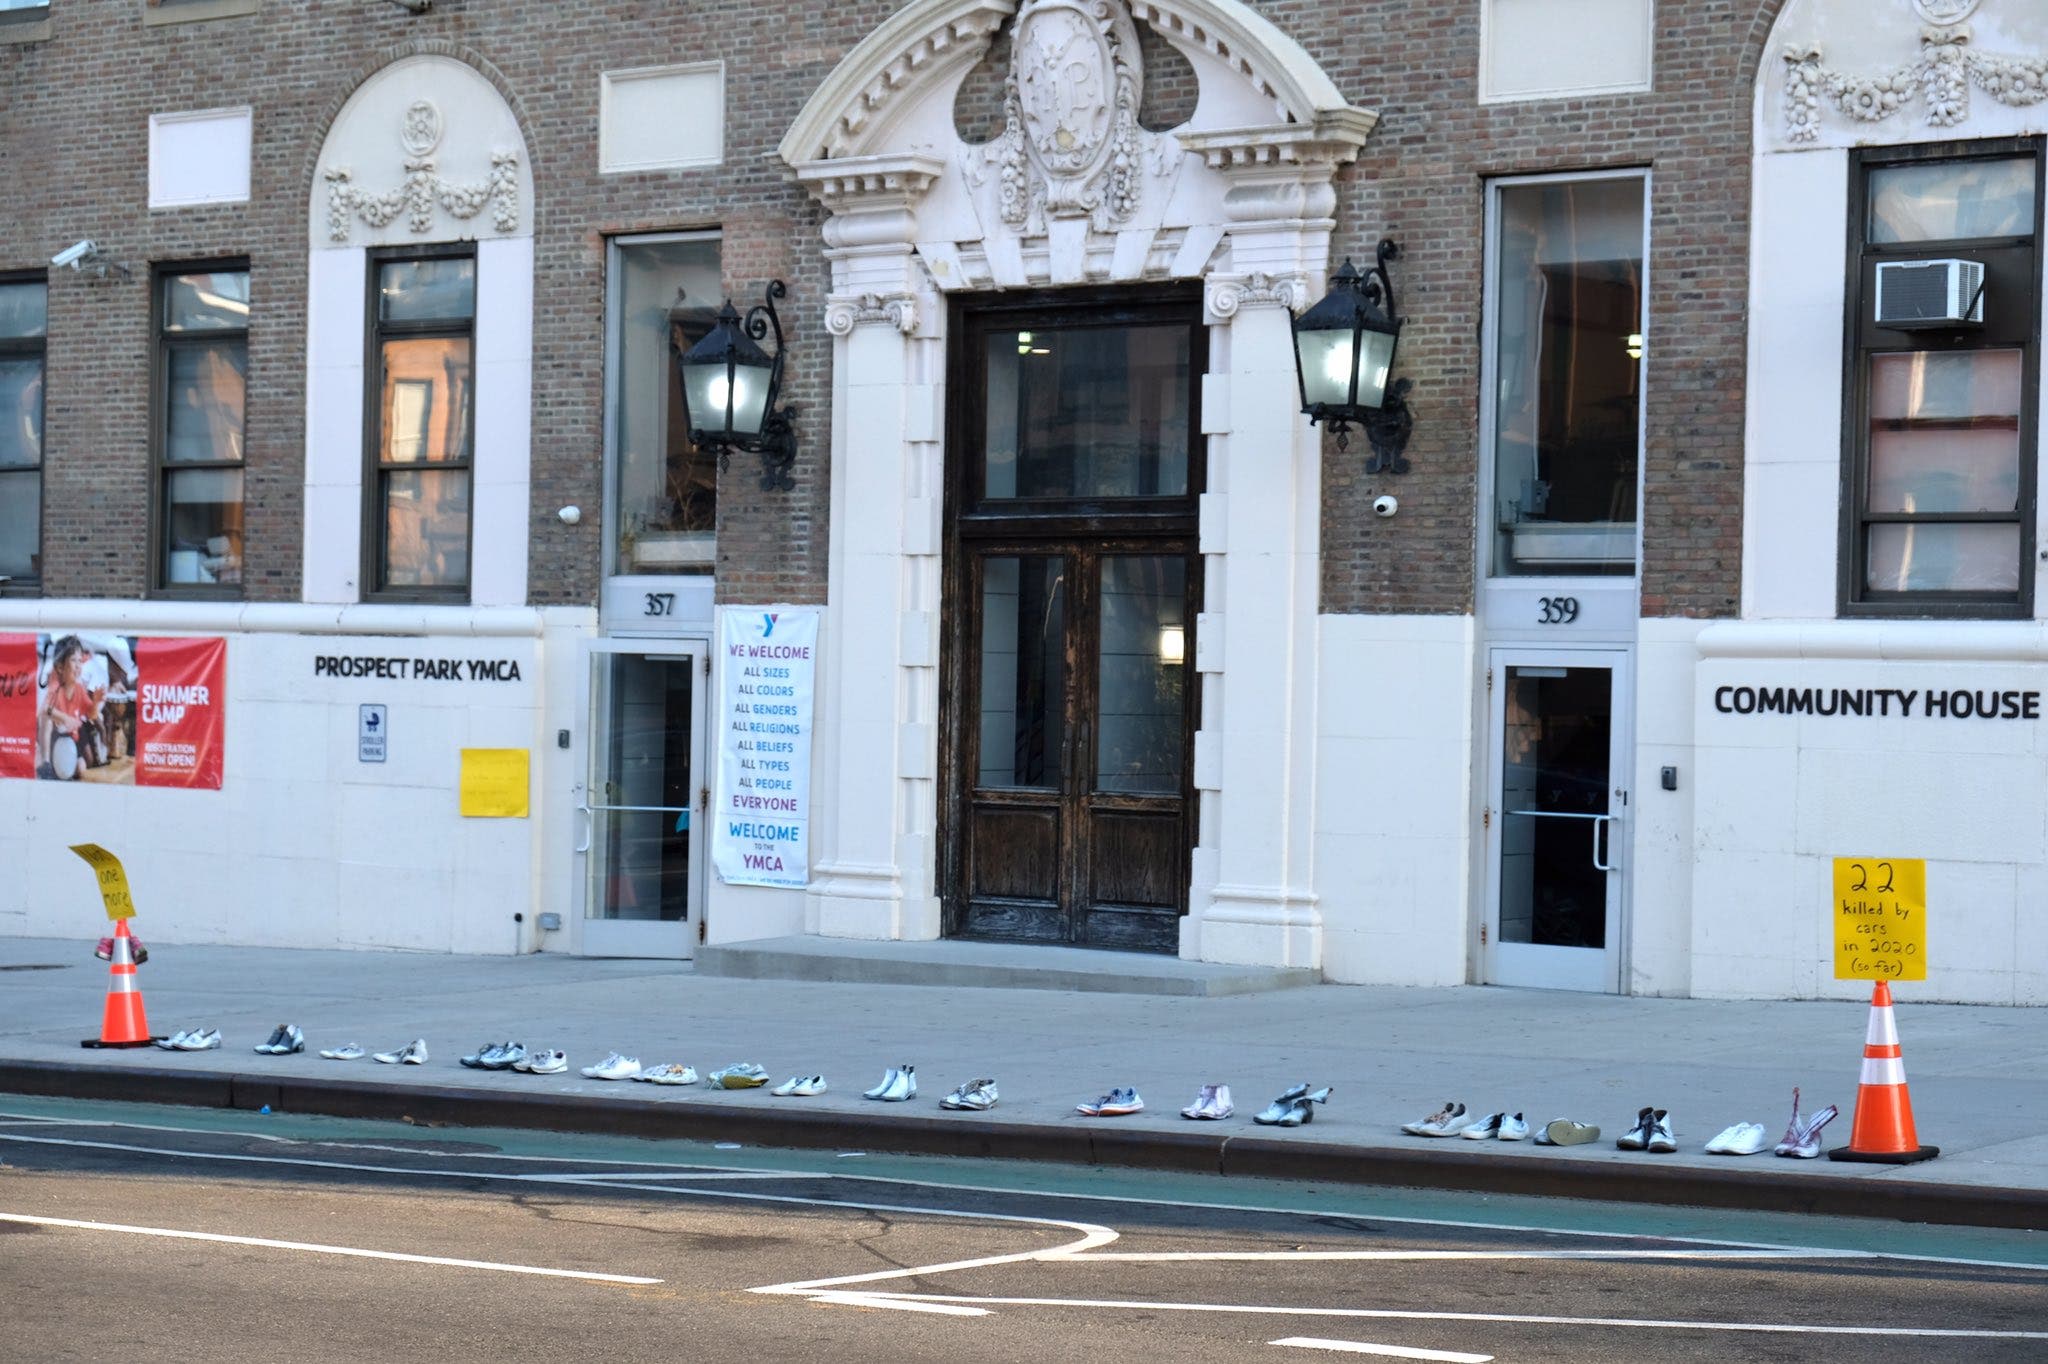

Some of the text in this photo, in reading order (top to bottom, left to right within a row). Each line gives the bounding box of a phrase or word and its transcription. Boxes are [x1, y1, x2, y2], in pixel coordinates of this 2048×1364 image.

[644, 593, 676, 615] 357
[1537, 597, 1579, 624] 359
[729, 645, 810, 659] WE WELCOME
[315, 656, 521, 681] PROSPECT PARK YMCA
[744, 667, 790, 678] ALL SIZES
[141, 684, 209, 705] SUMMER
[738, 684, 794, 696] ALL COLORS
[735, 703, 798, 716] ALL GENDERS
[1715, 685, 2040, 719] COMMUNITY HOUSE
[141, 705, 185, 724] CAMP
[732, 721, 800, 735] ALL RELIGIONS
[738, 740, 794, 753] ALL BELIEFS
[143, 752, 166, 765] NOW
[741, 759, 790, 772] ALL TYPES
[738, 777, 792, 790] ALL PEOPLE
[733, 795, 798, 811] EVERYONE
[729, 822, 800, 842] WELCOME
[743, 854, 784, 872] YMCA
[1851, 862, 1894, 893] 22
[1842, 900, 1910, 920] killed by
[1856, 924, 1887, 935] cars
[1844, 938, 1916, 955] in 2020
[1851, 957, 1903, 976] (so far)
